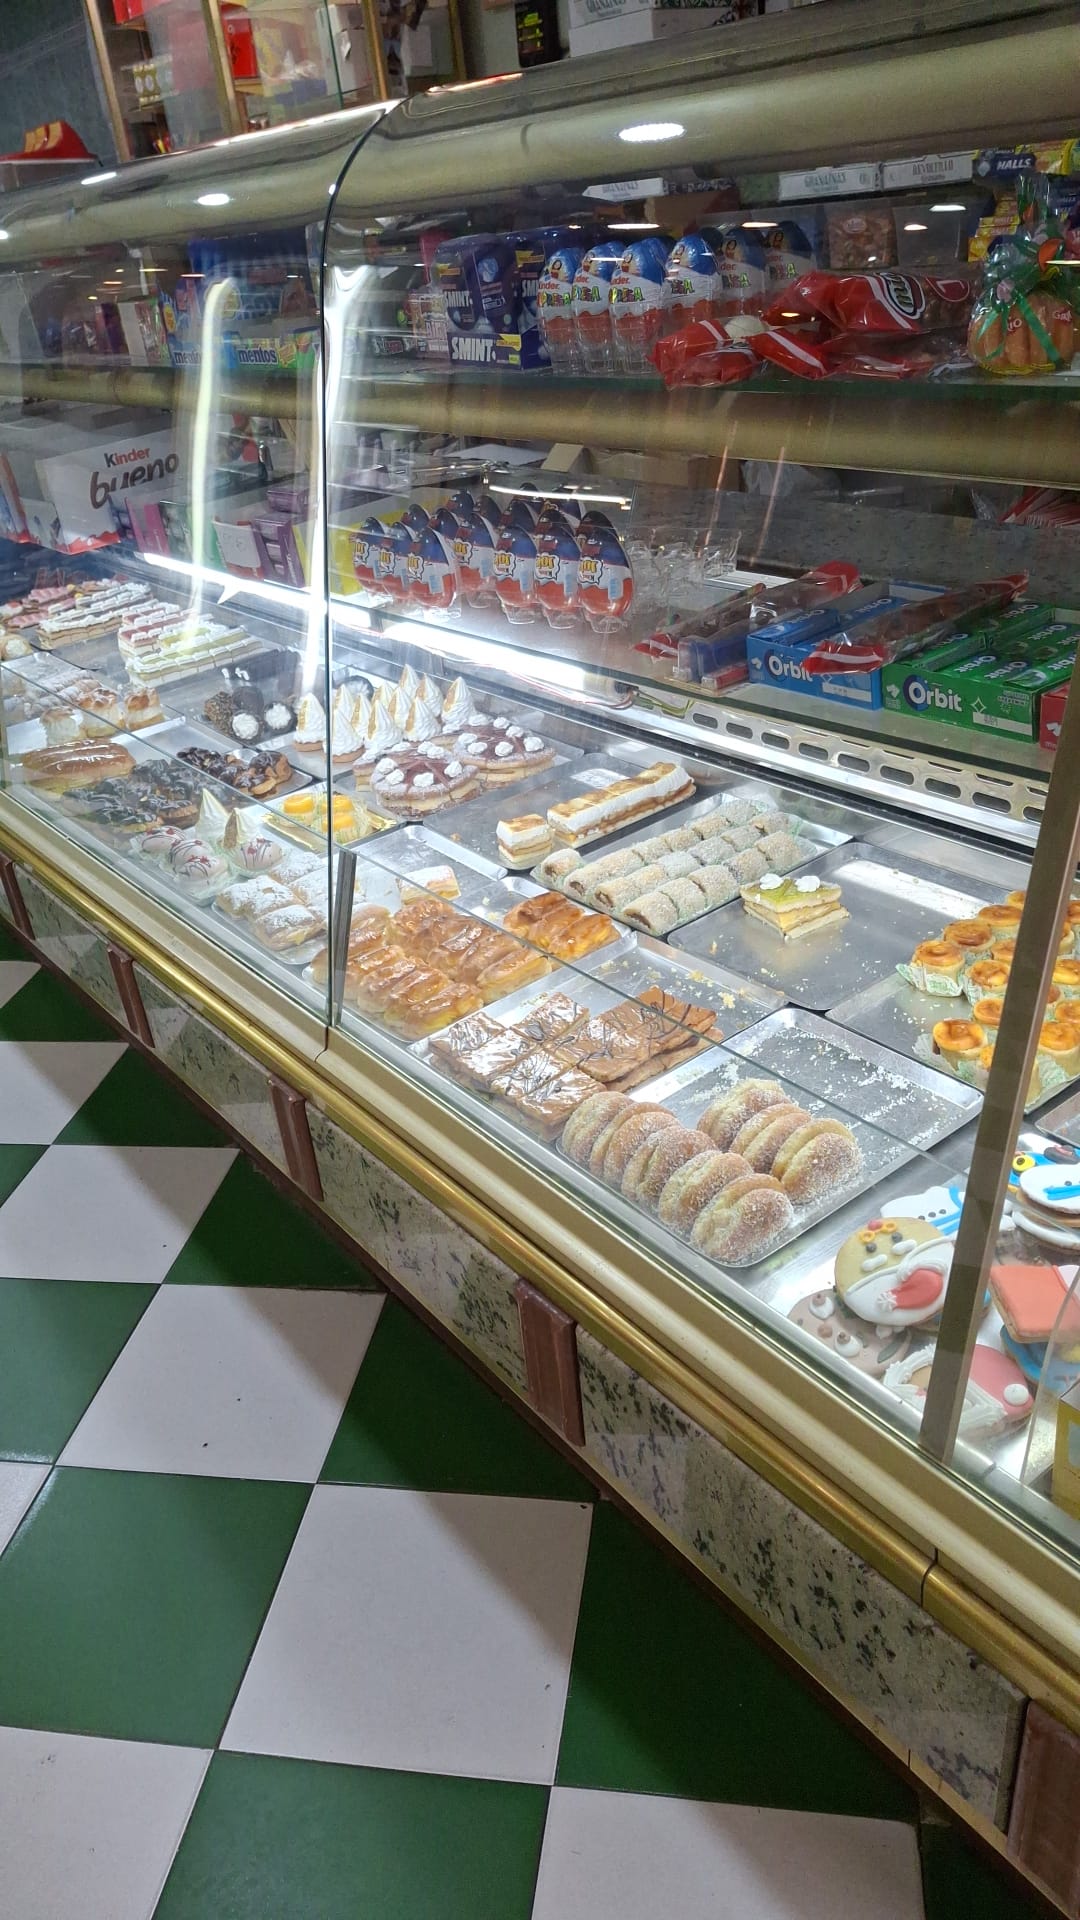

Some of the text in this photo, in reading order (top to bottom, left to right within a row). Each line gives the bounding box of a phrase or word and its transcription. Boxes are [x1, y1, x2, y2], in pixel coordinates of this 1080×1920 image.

[996, 157, 1032, 171] HALLS
[444, 290, 470, 308] SMINT
[238, 347, 278, 364] mentos
[451, 336, 493, 363] SMINT
[104, 447, 150, 468] Kinder
[90, 453, 180, 510] bueno
[952, 655, 996, 673] Orbit
[984, 661, 1028, 680] Orbit
[908, 681, 963, 712] Orbit
